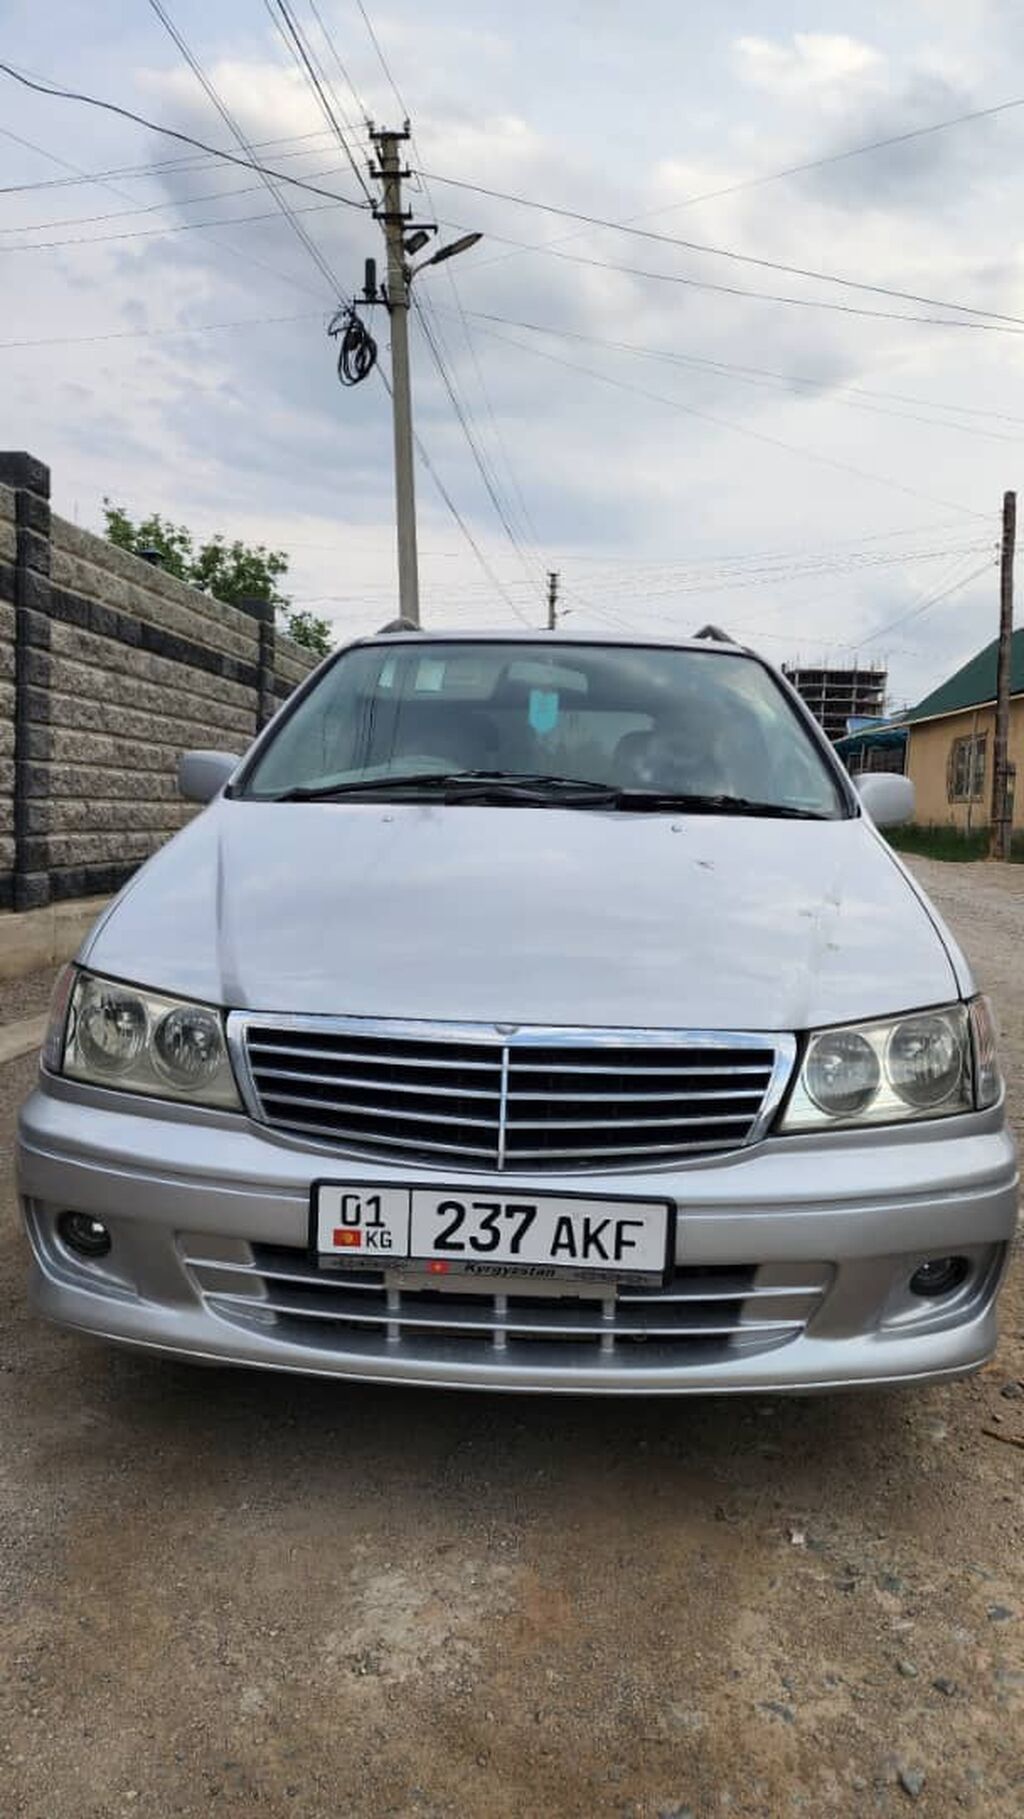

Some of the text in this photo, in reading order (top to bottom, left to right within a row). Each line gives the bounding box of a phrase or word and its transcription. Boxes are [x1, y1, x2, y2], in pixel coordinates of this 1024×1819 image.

[341, 1194, 386, 1228] 01
[365, 1230, 393, 1249] KG
[433, 1200, 645, 1261] 237 AKF
